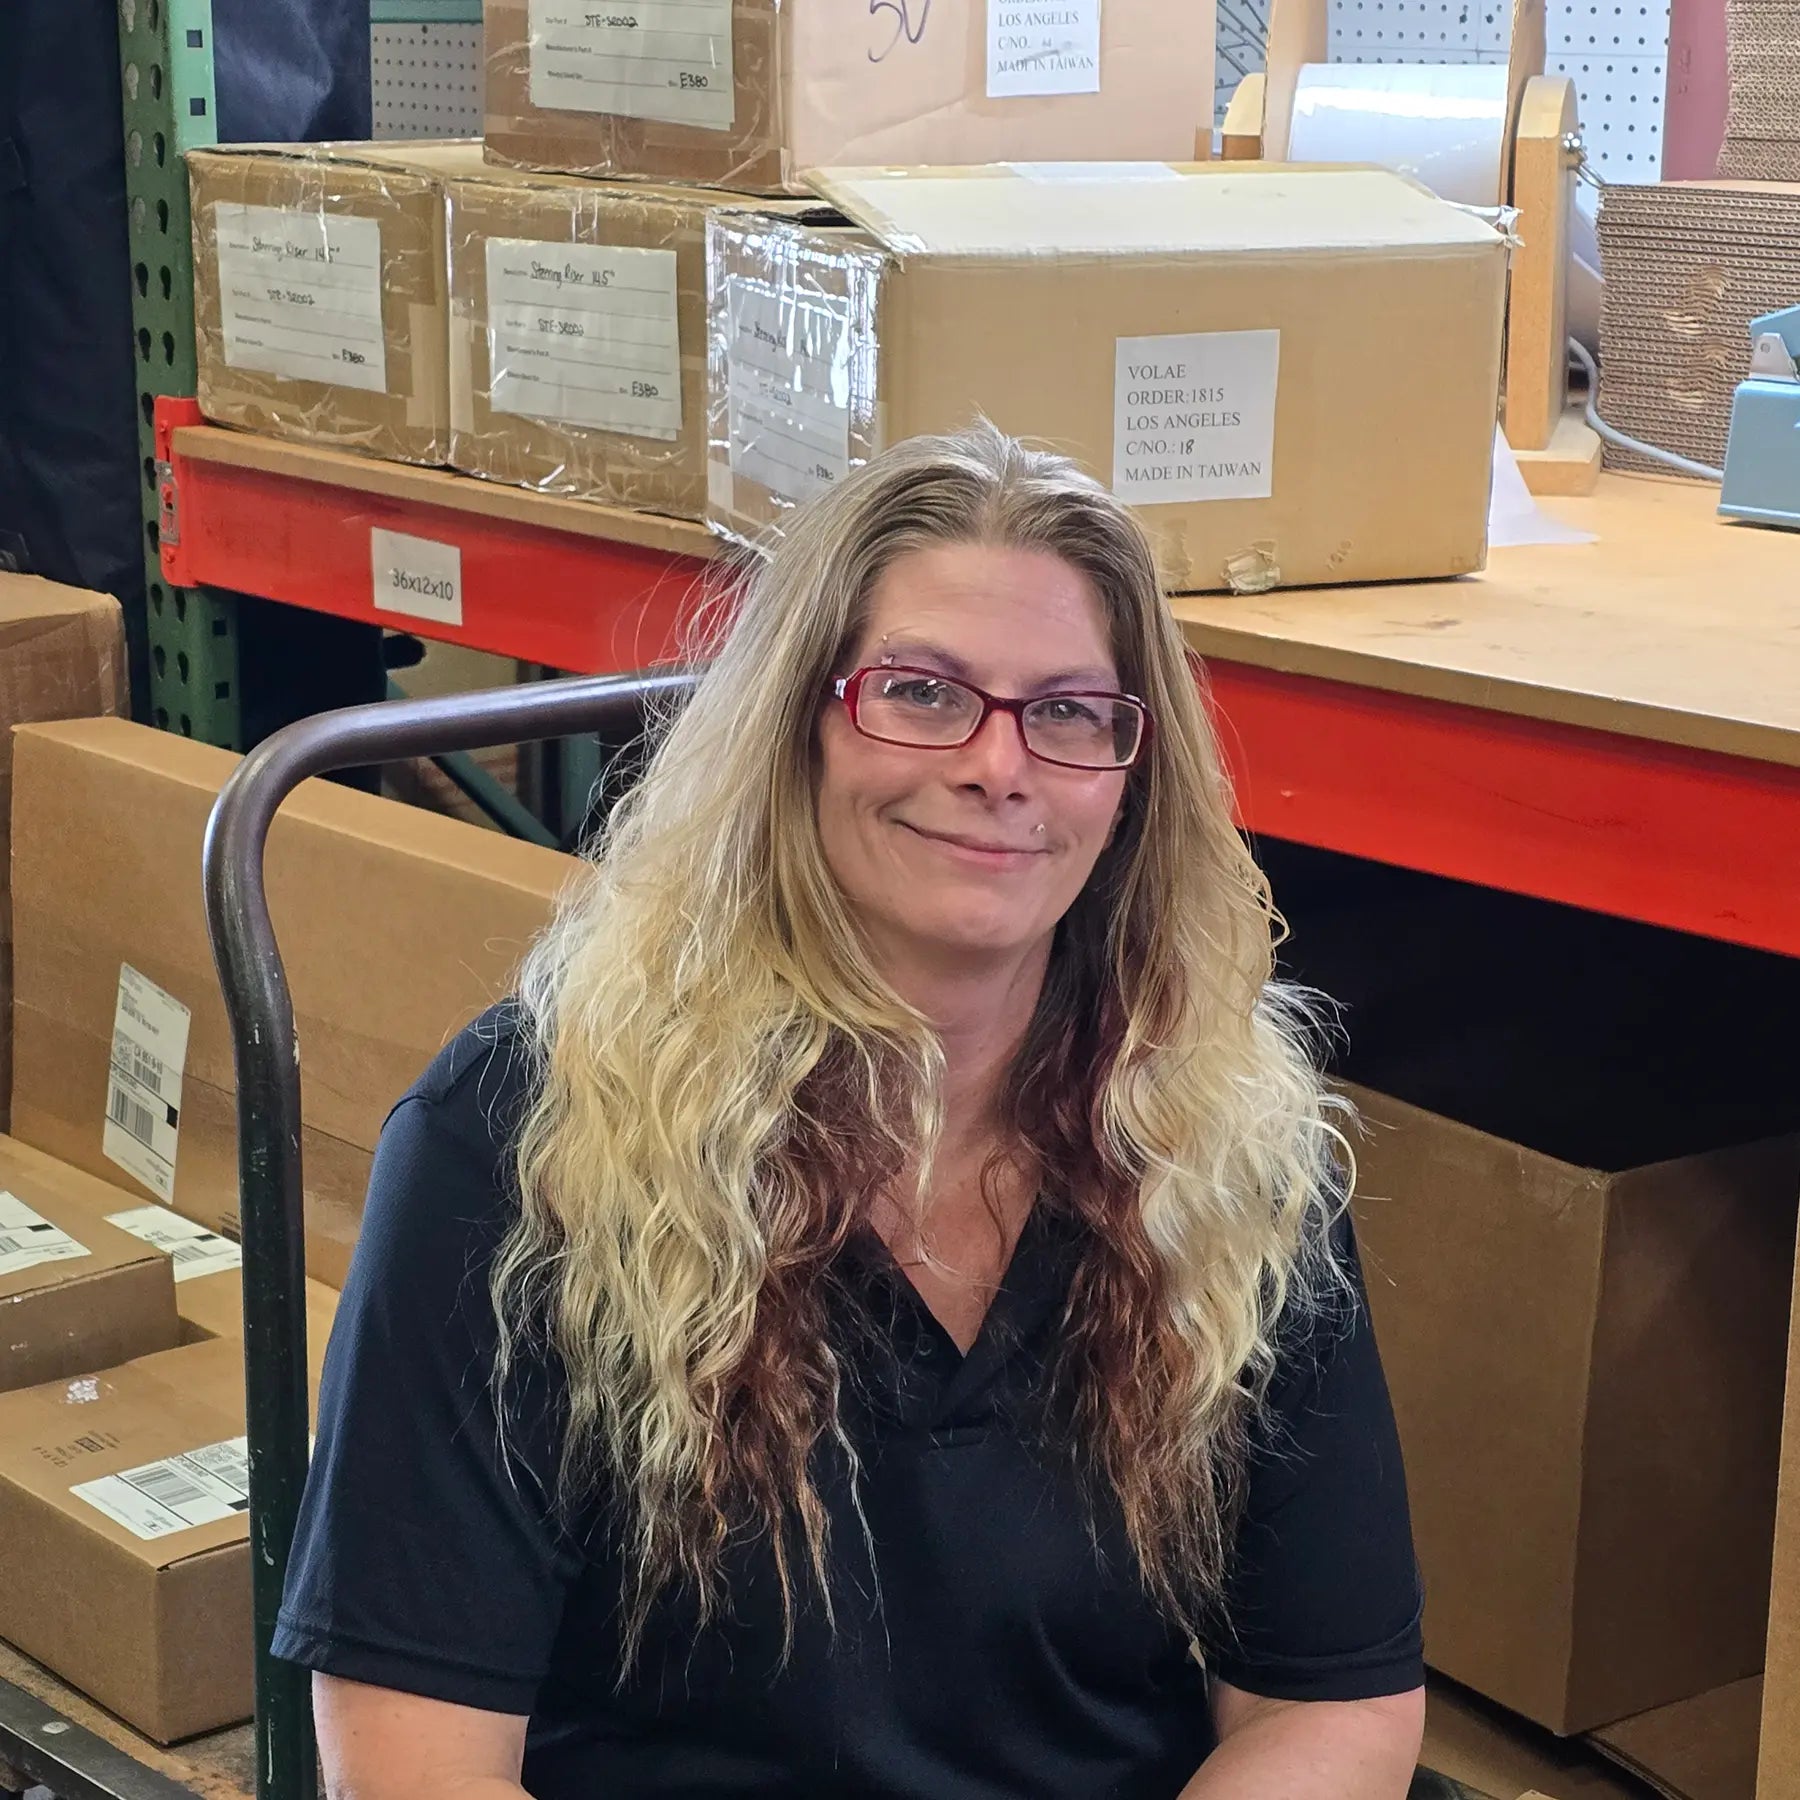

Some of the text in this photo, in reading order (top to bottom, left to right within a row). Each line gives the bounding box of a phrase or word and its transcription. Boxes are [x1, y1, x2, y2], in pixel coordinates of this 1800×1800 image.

[998, 11, 1080, 28] LOS ANGELES
[997, 58, 1029, 73] MADE
[1048, 56, 1094, 71] TAIWAN
[680, 72, 709, 89] E380
[1128, 364, 1187, 381] VOLAE
[632, 380, 659, 398] E380
[1127, 388, 1225, 406] ORDER:1815
[1127, 411, 1242, 431] LOS ANGELES
[1179, 438, 1196, 456] 18
[1125, 461, 1262, 482] MADE IN TAIWAN
[392, 567, 454, 601] 36x12x10
